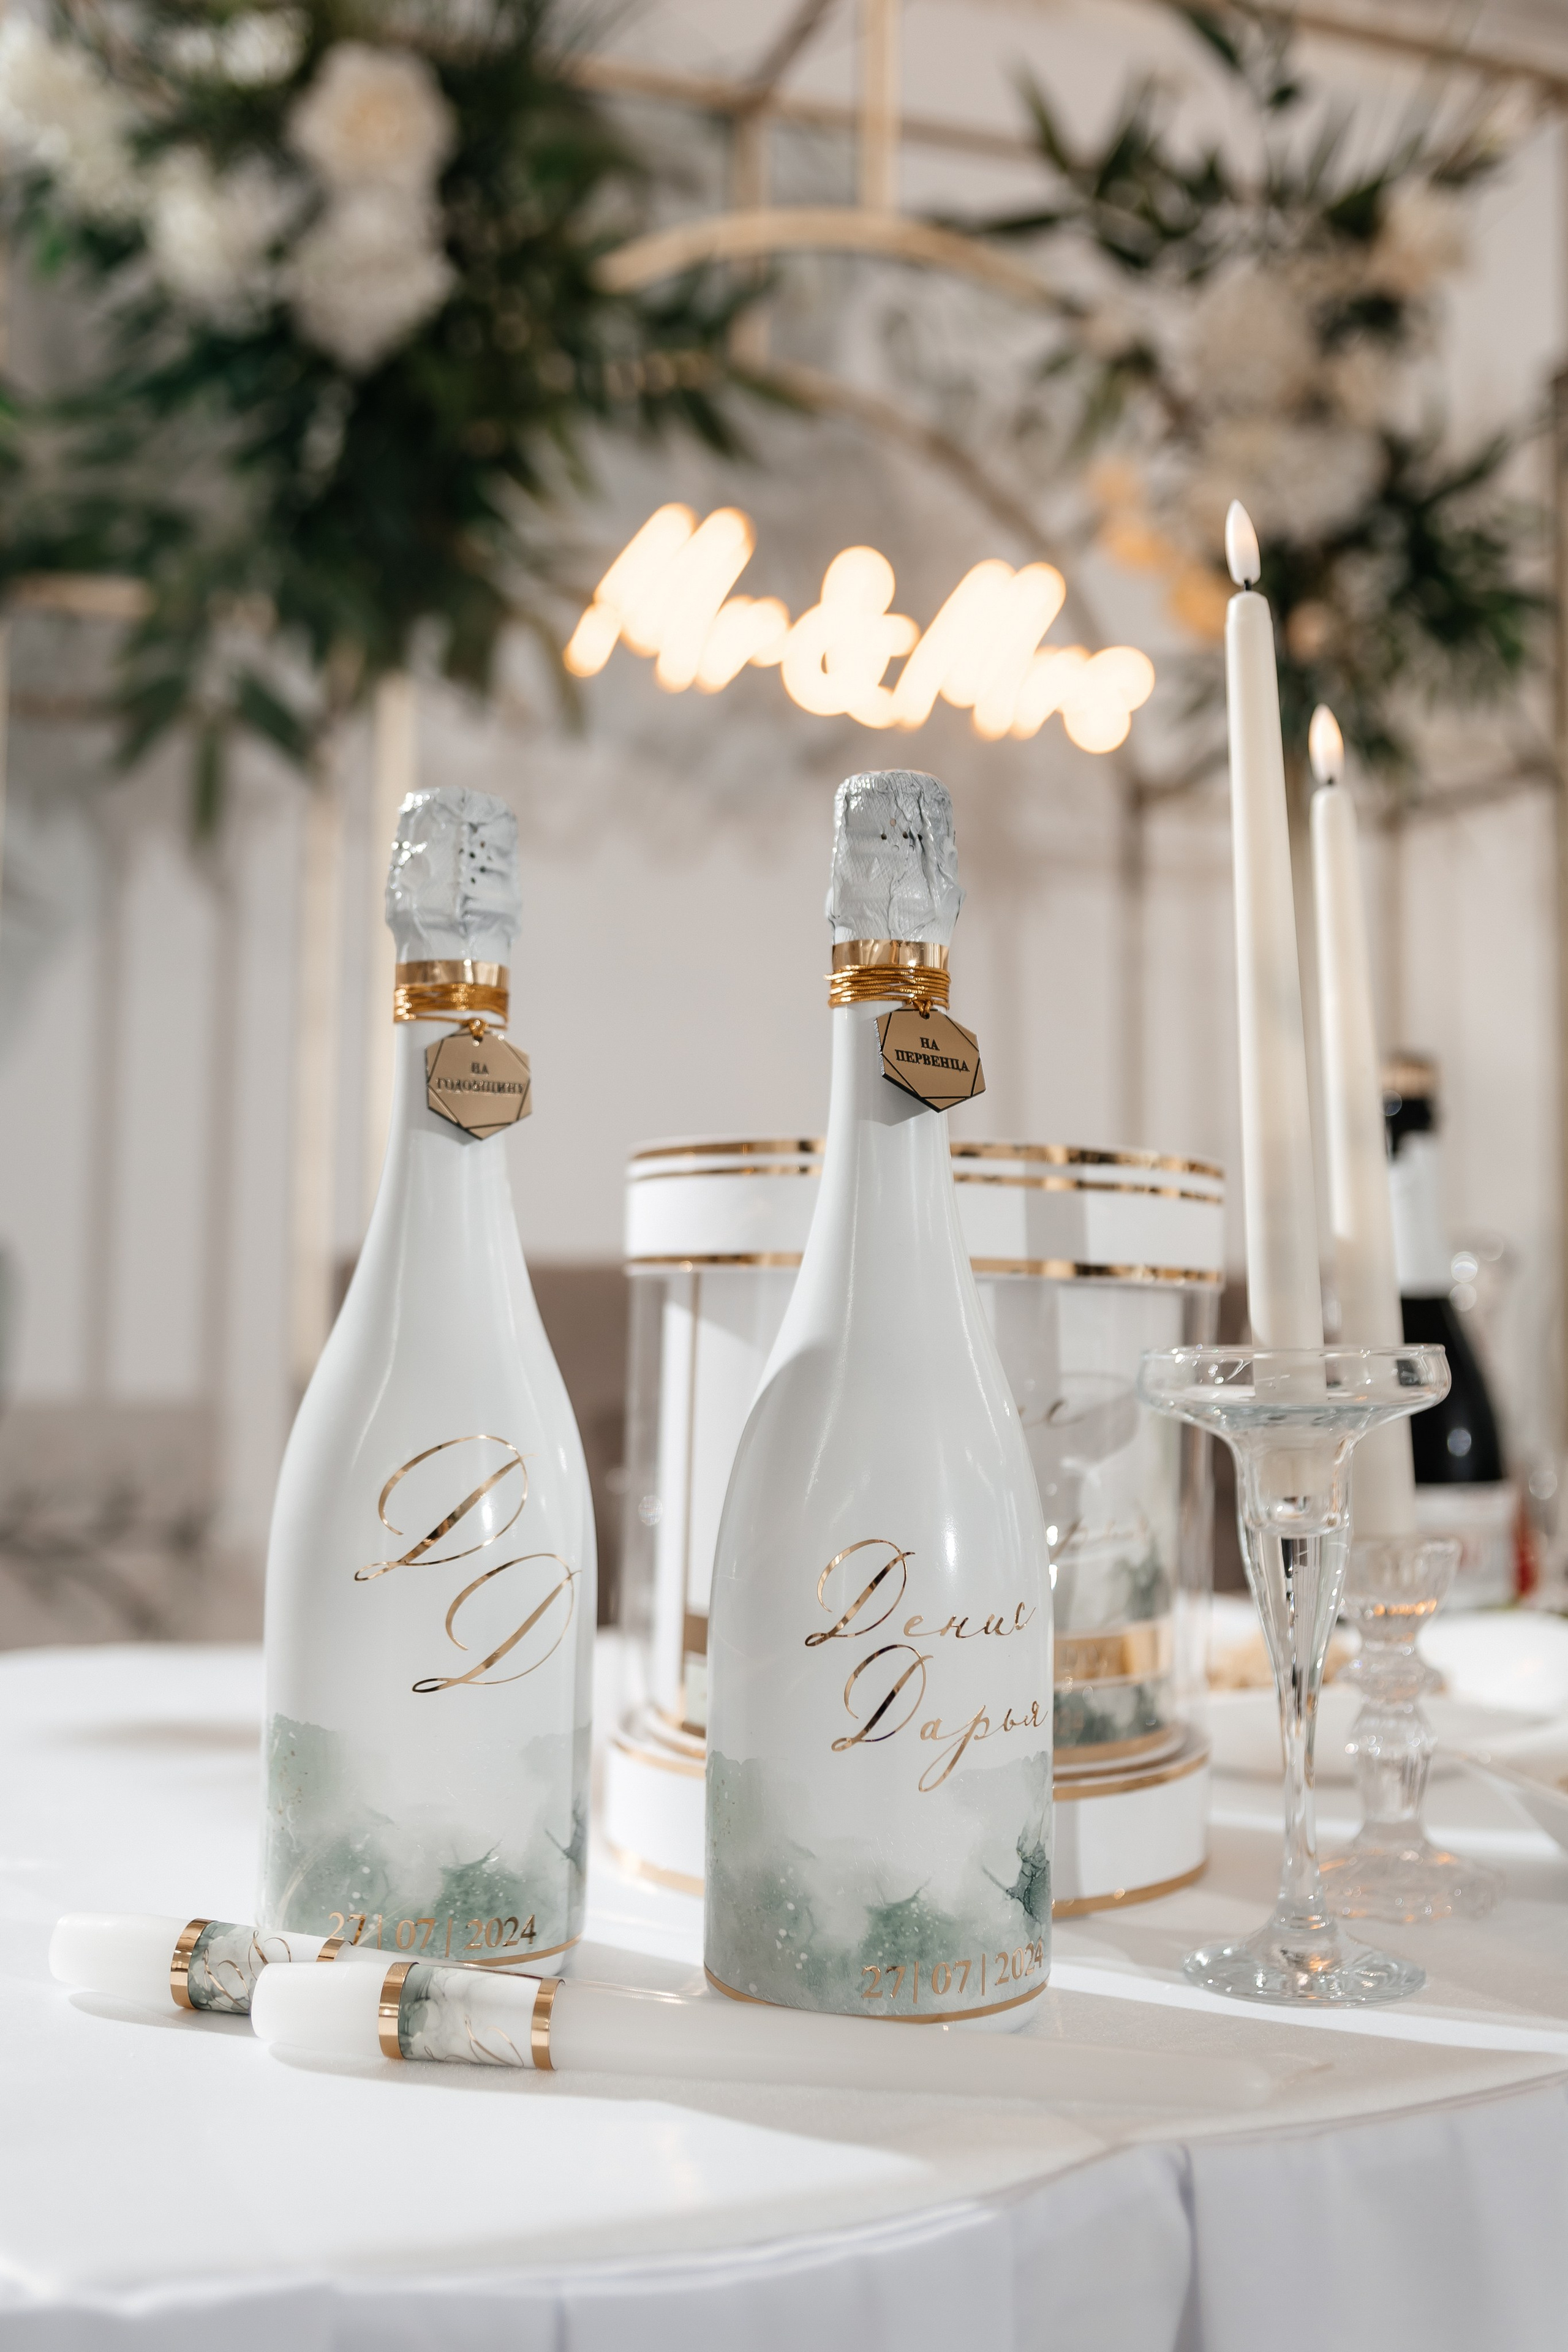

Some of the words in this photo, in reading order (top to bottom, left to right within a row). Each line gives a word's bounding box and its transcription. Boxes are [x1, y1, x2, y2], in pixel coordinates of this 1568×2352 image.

[894, 1049, 970, 1072] ПЕРВЕНЦА
[919, 1037, 940, 1051] НА
[804, 1539, 1036, 1647] Денис
[831, 1644, 1049, 1793] Дарья
